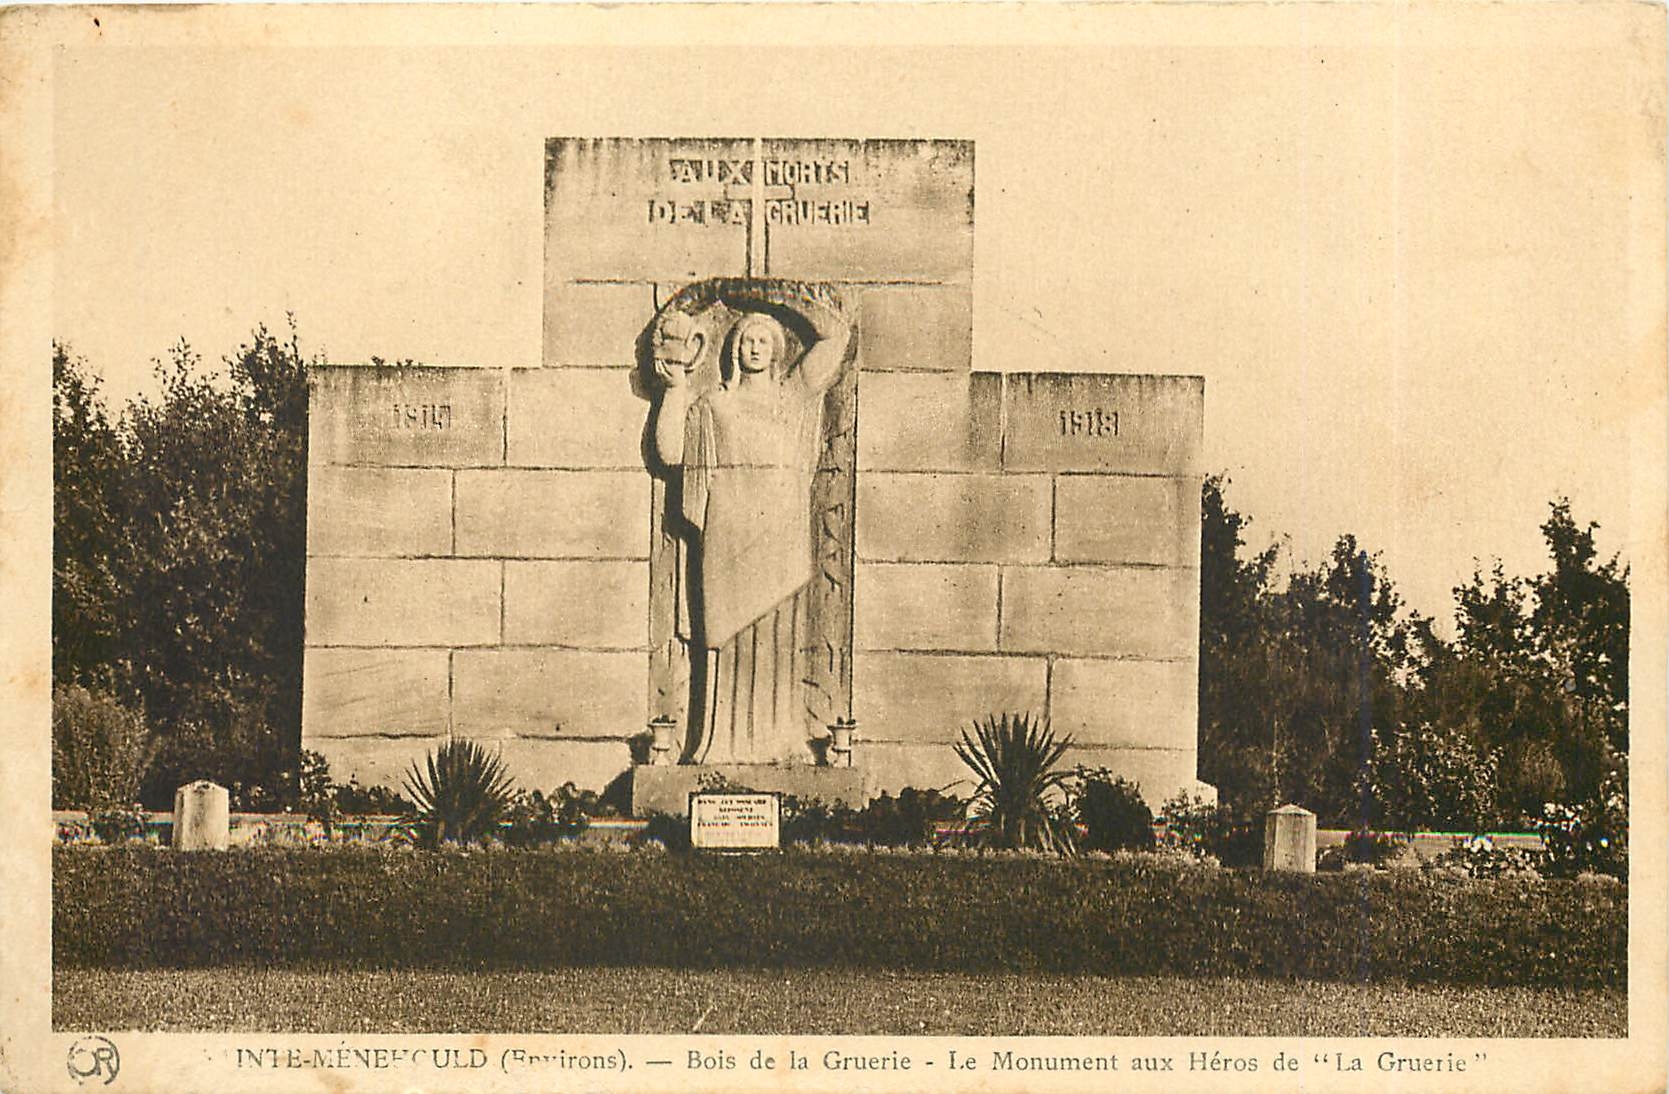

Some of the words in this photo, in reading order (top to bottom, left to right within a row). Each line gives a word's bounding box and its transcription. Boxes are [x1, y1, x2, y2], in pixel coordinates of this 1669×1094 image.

[669, 158, 753, 185] AUX
[763, 159, 850, 185] MORTS
[648, 199, 705, 225] DE
[708, 199, 753, 225] LA
[765, 200, 871, 225] GRUERIE
